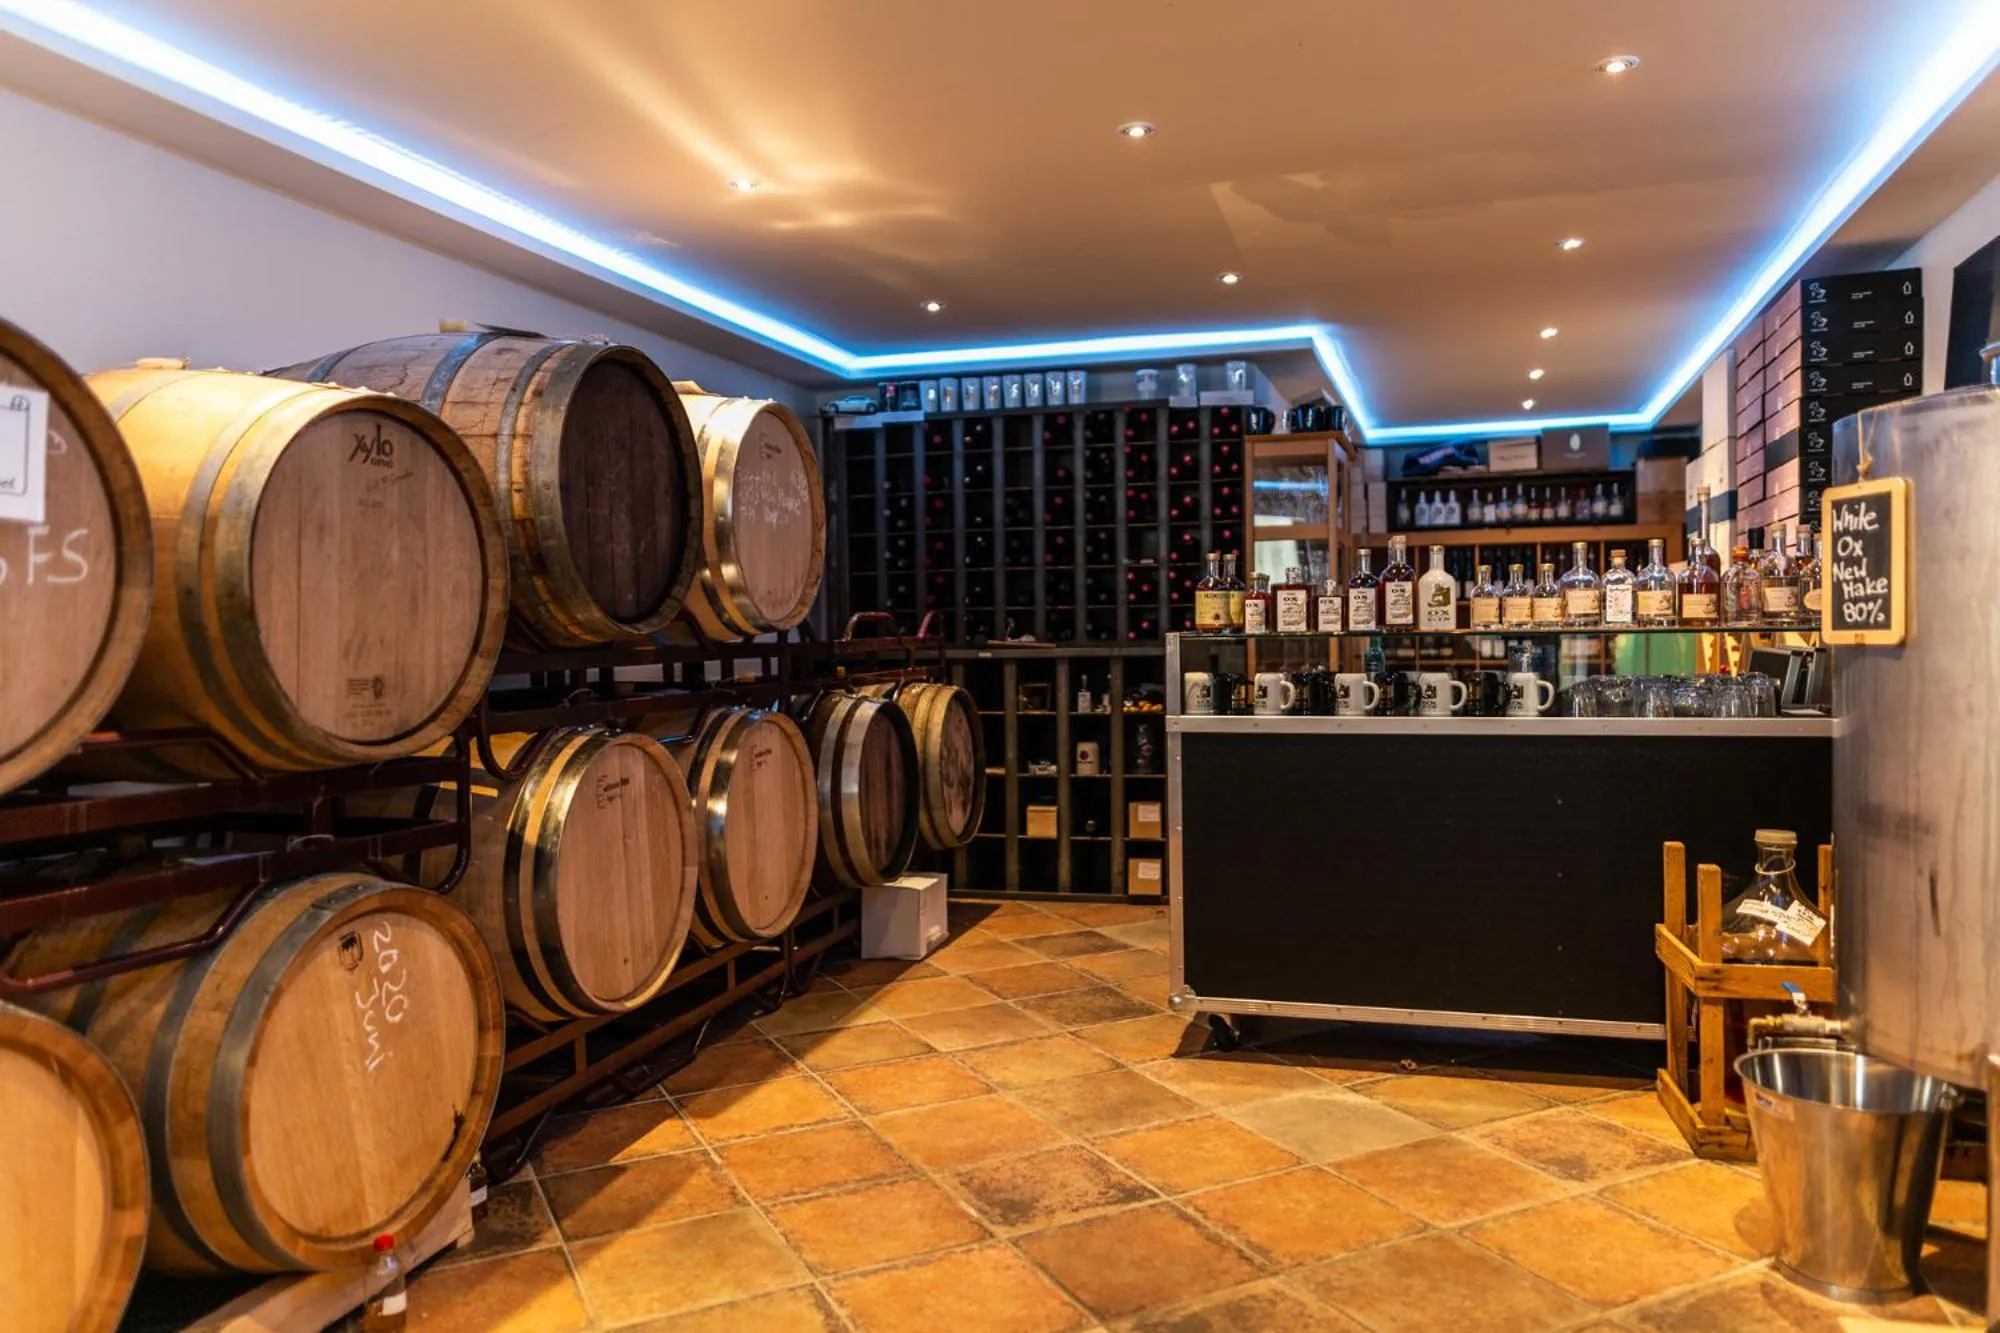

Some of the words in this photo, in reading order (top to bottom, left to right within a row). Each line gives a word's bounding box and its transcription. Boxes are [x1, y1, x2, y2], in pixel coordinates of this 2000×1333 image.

[1831, 501, 1880, 533] White
[1832, 557, 1868, 582] New
[1842, 577, 1889, 600] Make
[1842, 598, 1886, 626] 80%
